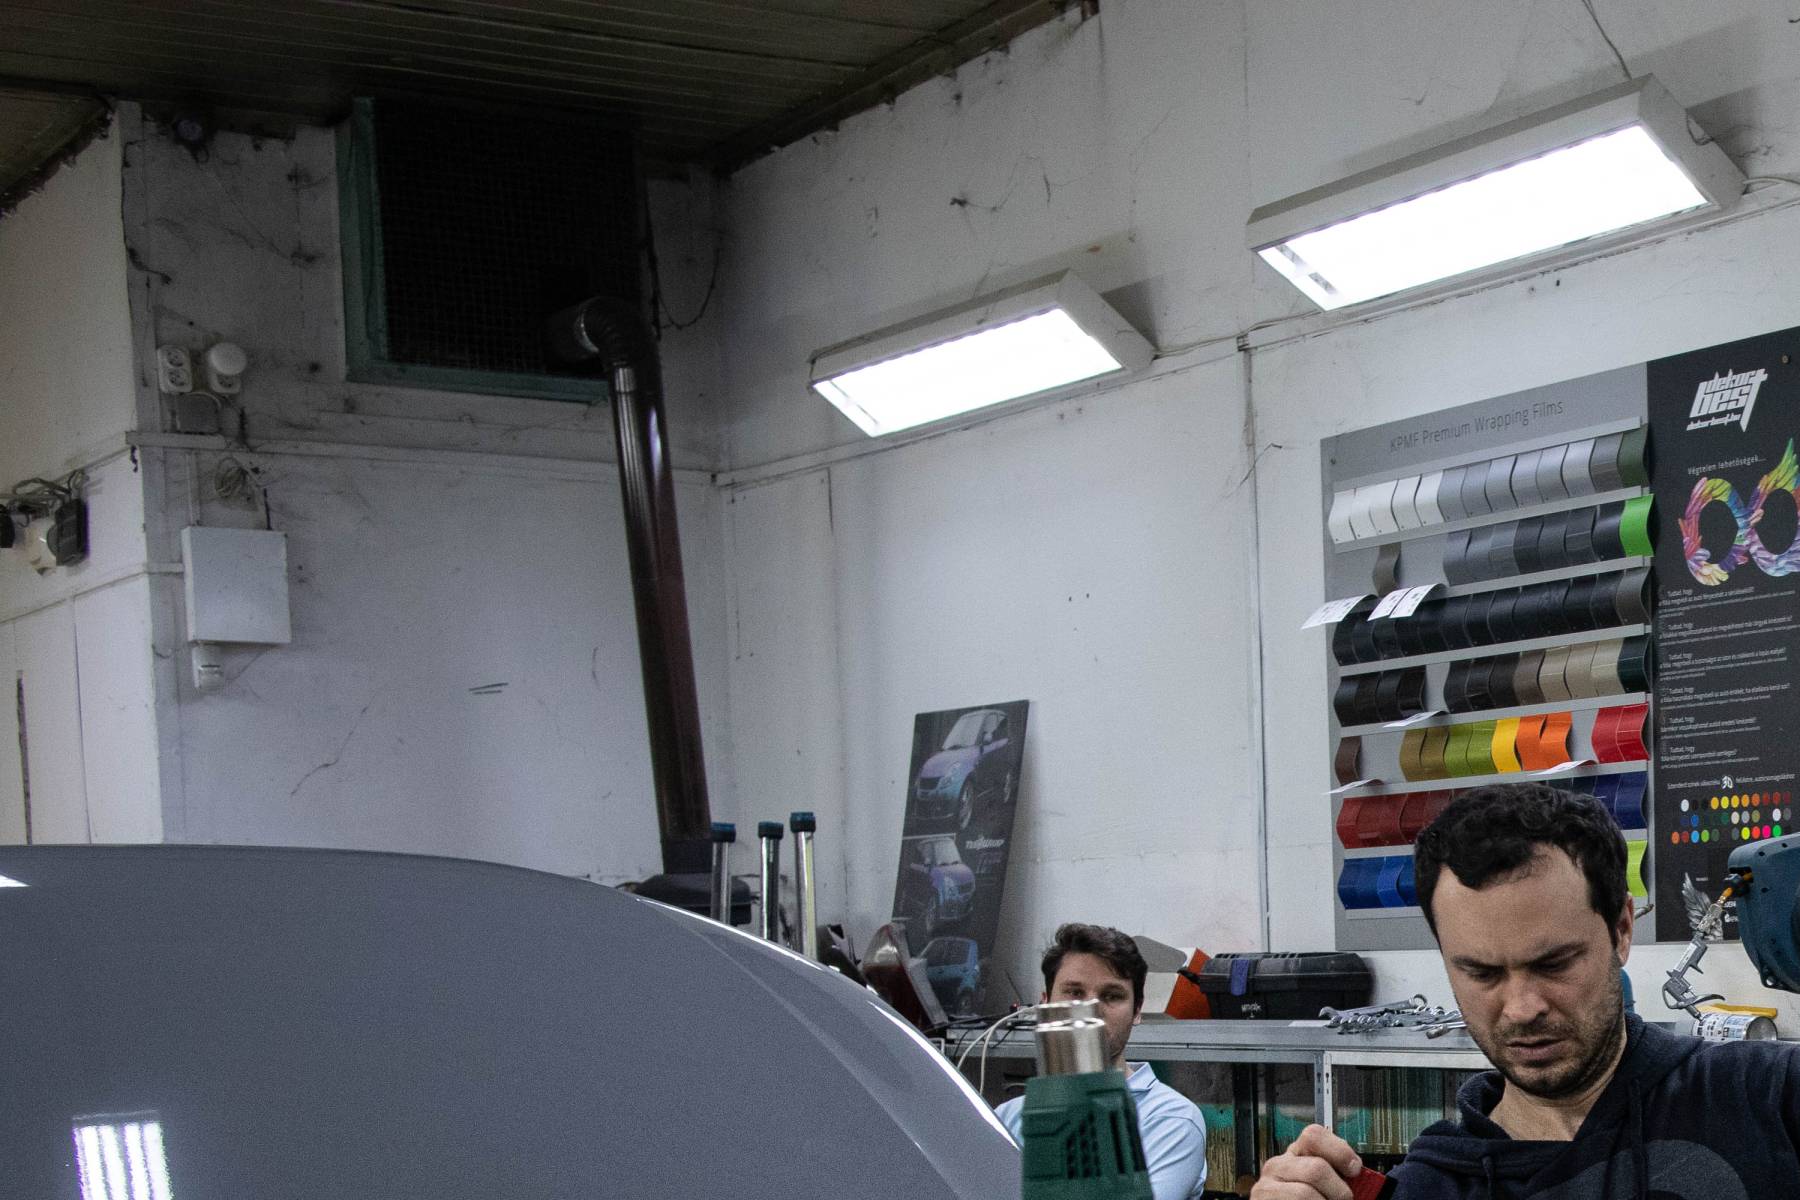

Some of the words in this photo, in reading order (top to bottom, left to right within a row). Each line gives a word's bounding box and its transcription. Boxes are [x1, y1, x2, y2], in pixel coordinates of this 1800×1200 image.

[1389, 431, 1420, 453] KPMF
[1422, 422, 1471, 445] Premium
[1474, 407, 1529, 434] Wrapping
[1533, 400, 1564, 420] Films
